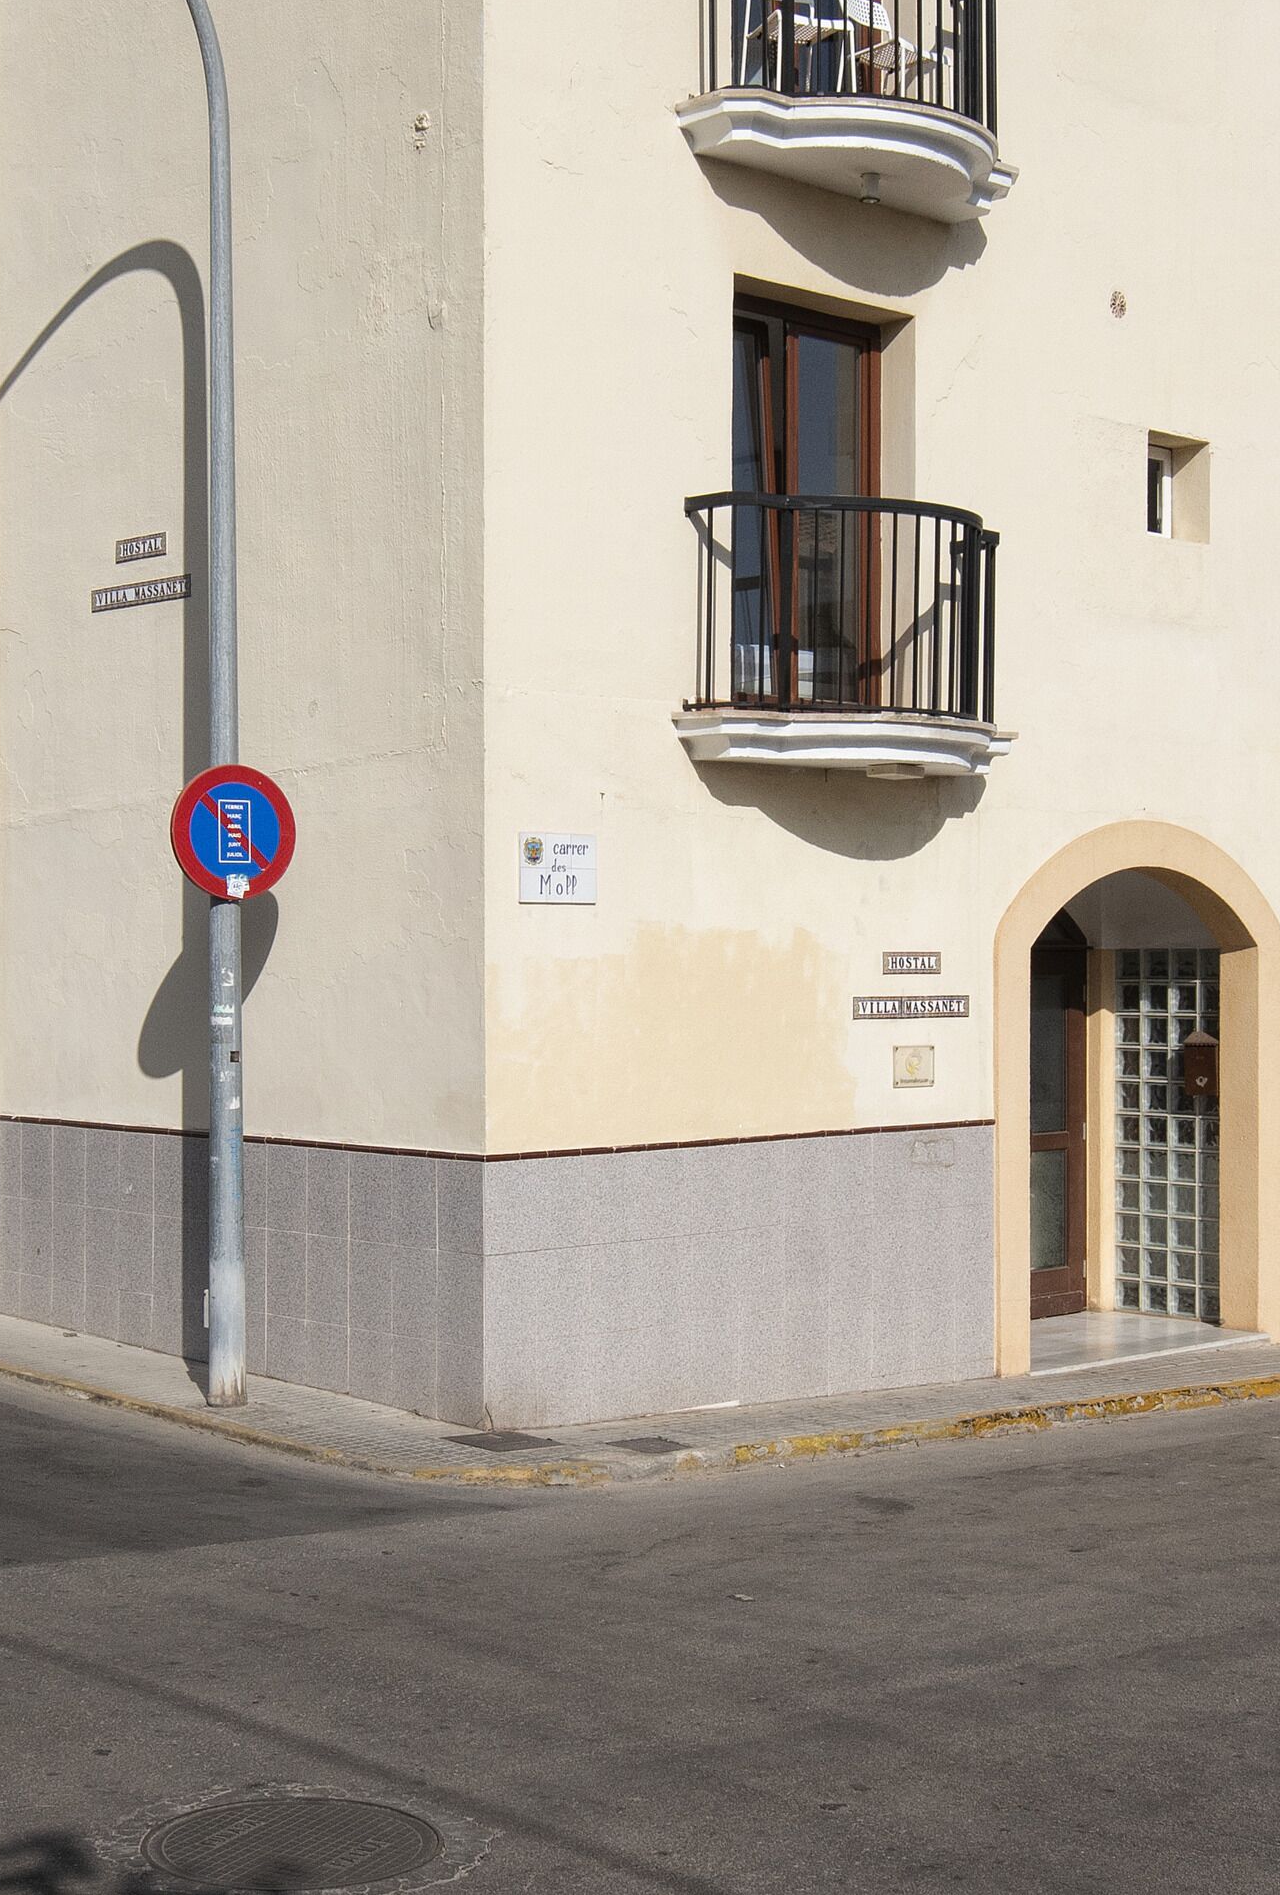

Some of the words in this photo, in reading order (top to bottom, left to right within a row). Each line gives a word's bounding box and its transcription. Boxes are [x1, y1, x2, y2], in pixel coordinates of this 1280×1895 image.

[122, 538, 161, 556] HOSTAL
[96, 590, 128, 605] VILLA
[134, 580, 186, 600] MASSANET
[553, 843, 589, 856] carrer
[551, 858, 567, 872] des
[890, 957, 934, 969] HOSTAL
[861, 1001, 898, 1013] VILLA
[905, 1000, 963, 1014] MASSANET
